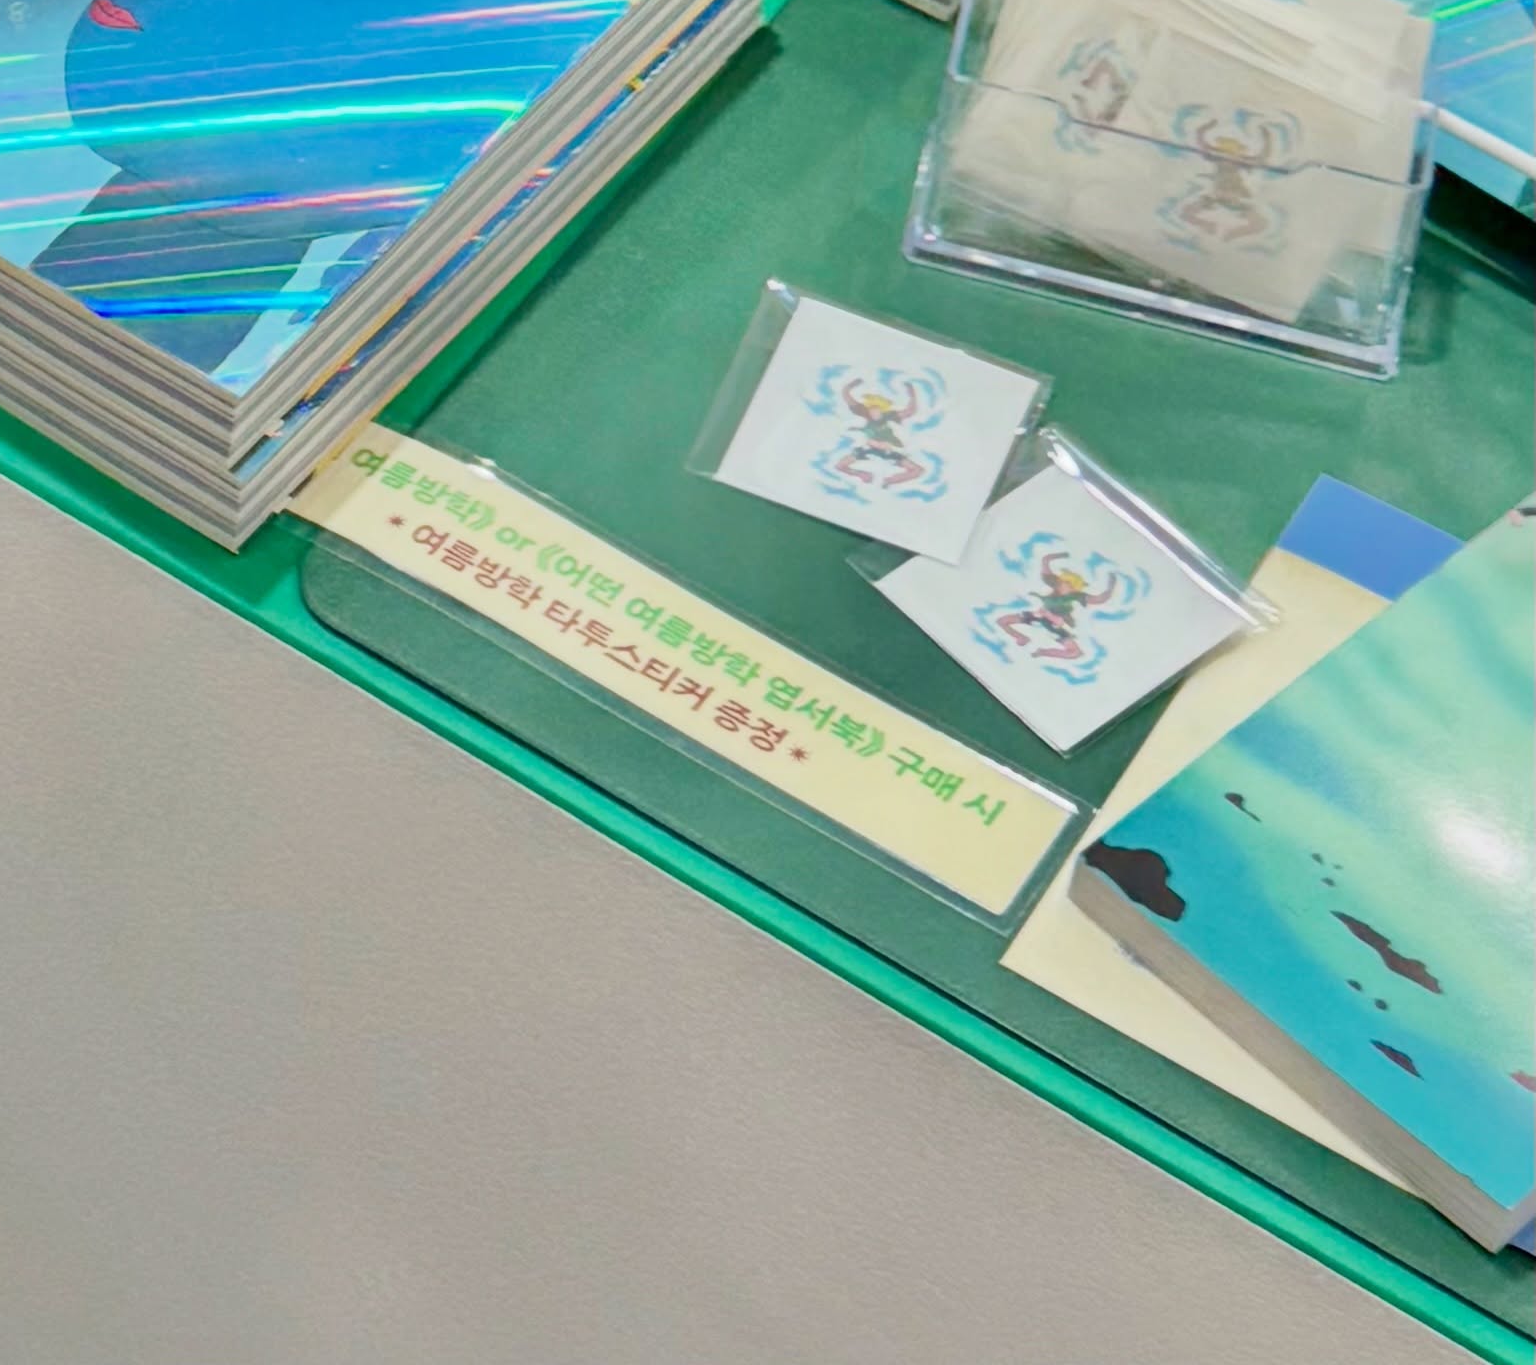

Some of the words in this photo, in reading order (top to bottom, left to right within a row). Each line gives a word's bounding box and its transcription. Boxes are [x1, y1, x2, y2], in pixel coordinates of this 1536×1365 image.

[413, 524, 544, 610] 여름방학
[542, 598, 714, 711] 타투스티커
[713, 698, 790, 753] 증정
[495, 525, 538, 552] or
[536, 543, 625, 608] 《어떤
[624, 597, 761, 687] 여름방학
[887, 746, 966, 803] 구매
[962, 793, 1007, 827] 시
